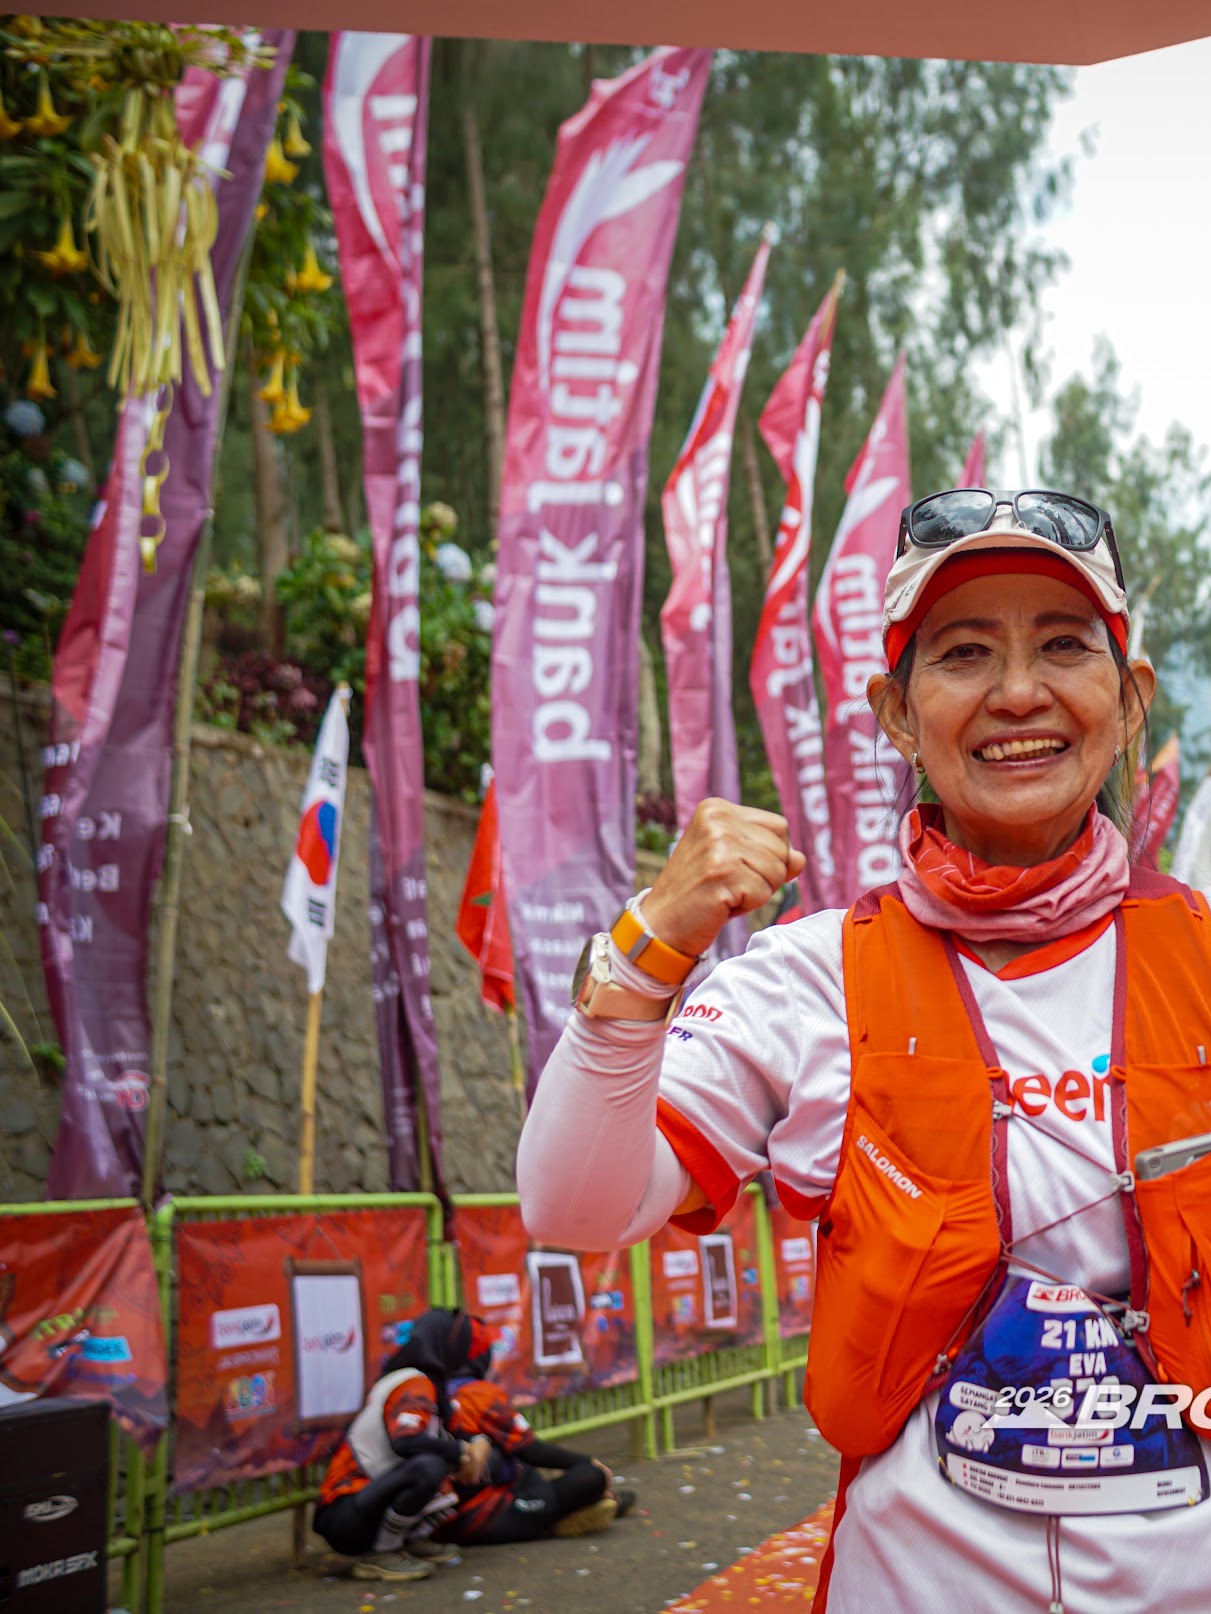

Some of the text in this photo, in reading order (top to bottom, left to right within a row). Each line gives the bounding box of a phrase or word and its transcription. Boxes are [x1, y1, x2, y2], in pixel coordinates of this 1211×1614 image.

[856, 1134, 923, 1200] SALOMON
[1041, 1317, 1119, 1350] 21 KM
[1069, 1351, 1107, 1376] EVA
